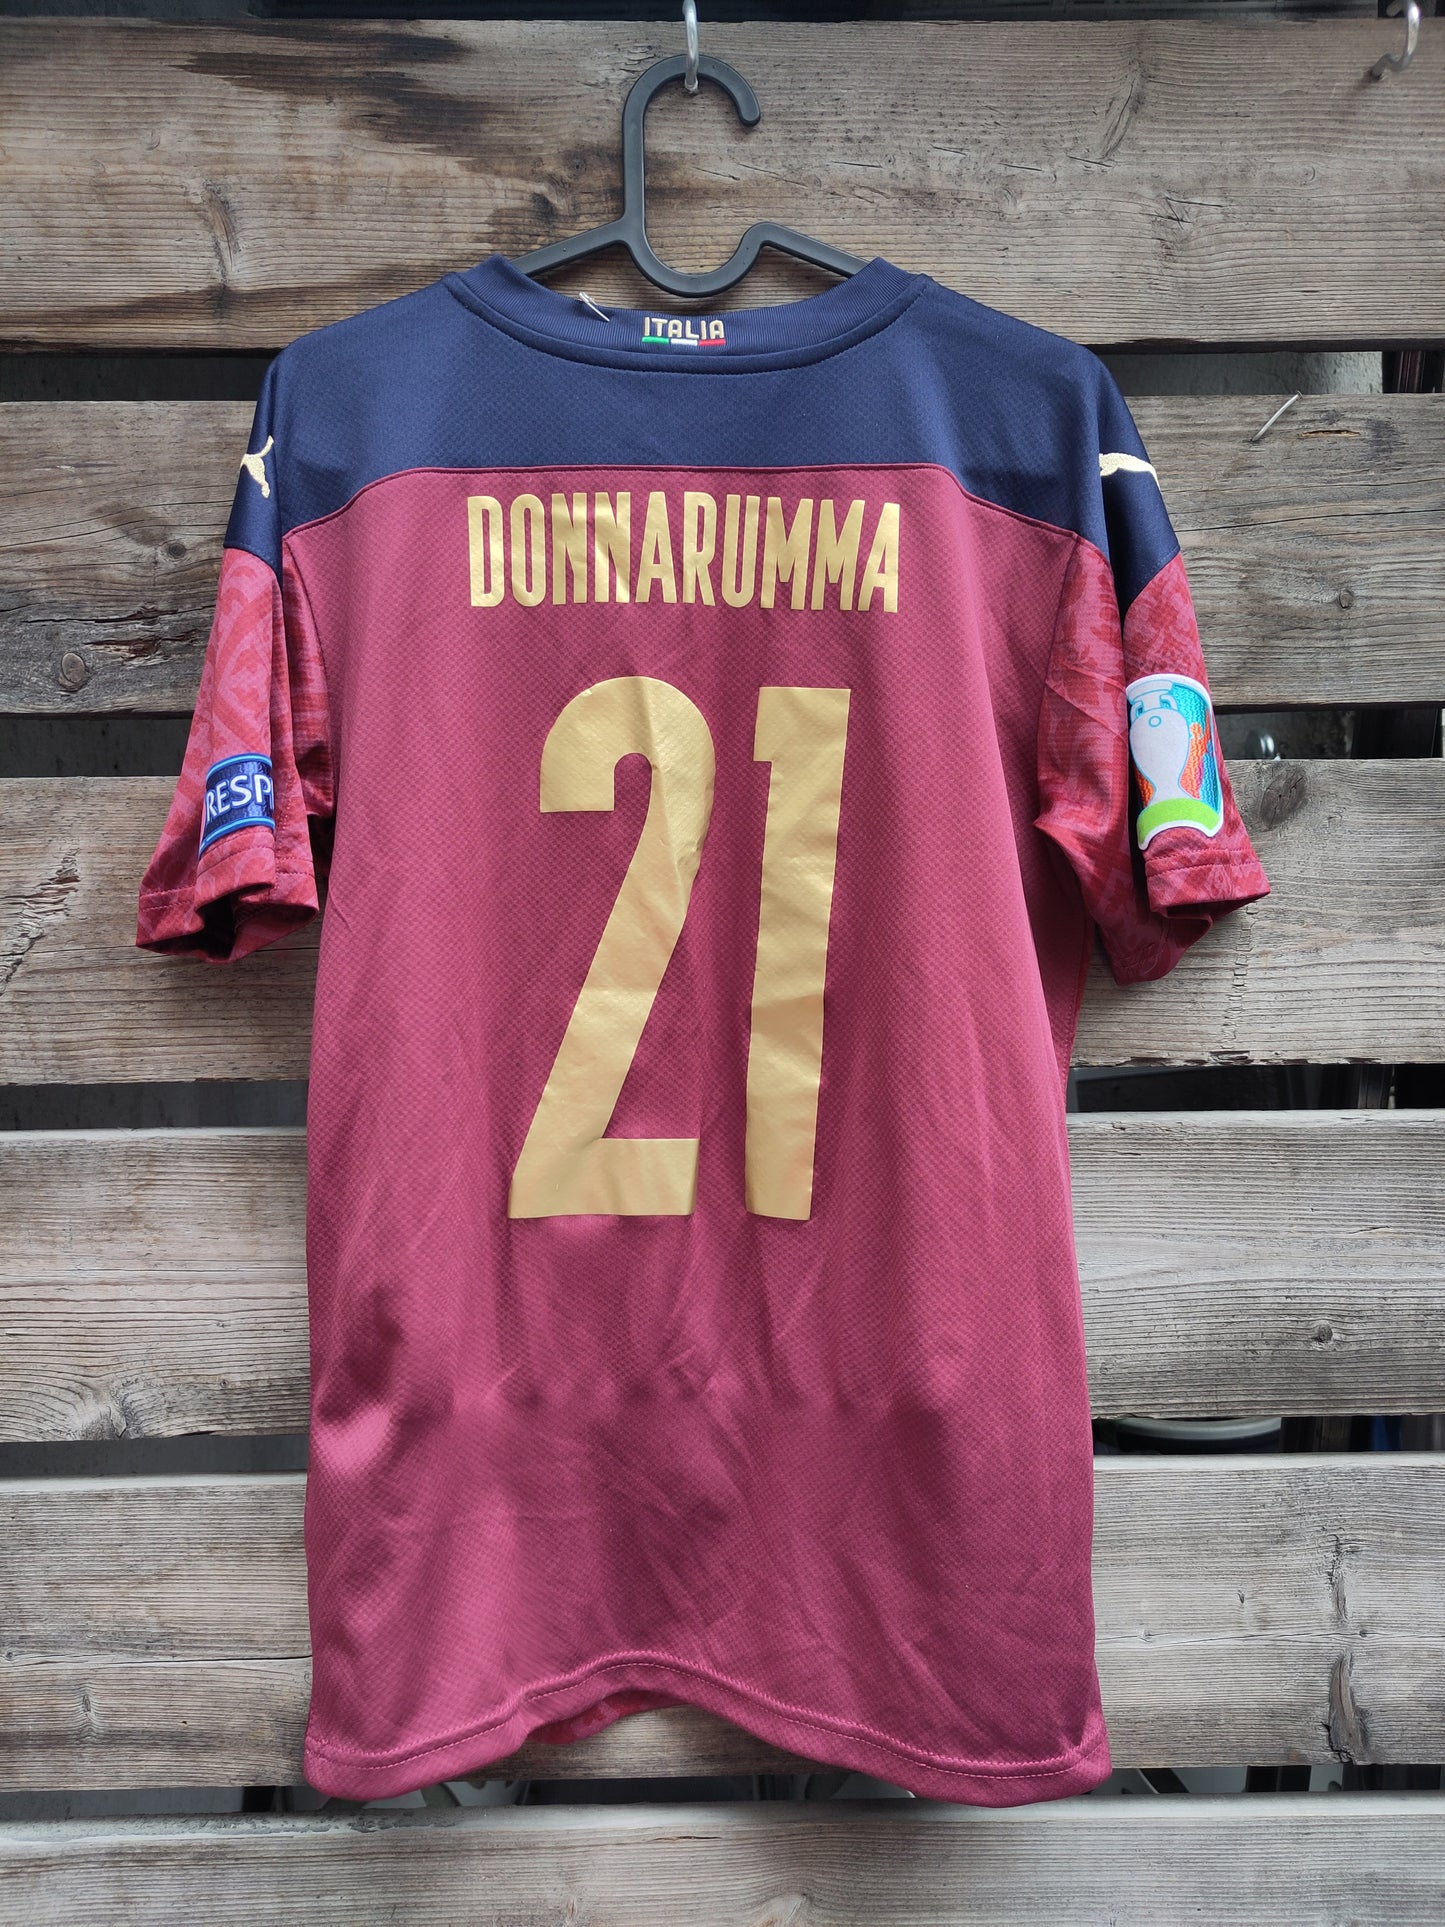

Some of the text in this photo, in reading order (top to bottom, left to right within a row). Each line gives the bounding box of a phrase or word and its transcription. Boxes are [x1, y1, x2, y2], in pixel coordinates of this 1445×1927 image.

[644, 316, 725, 340] ITALIA
[467, 491, 900, 613] DONNARUMMA
[206, 774, 274, 822] RESP
[508, 675, 851, 1221] 21
